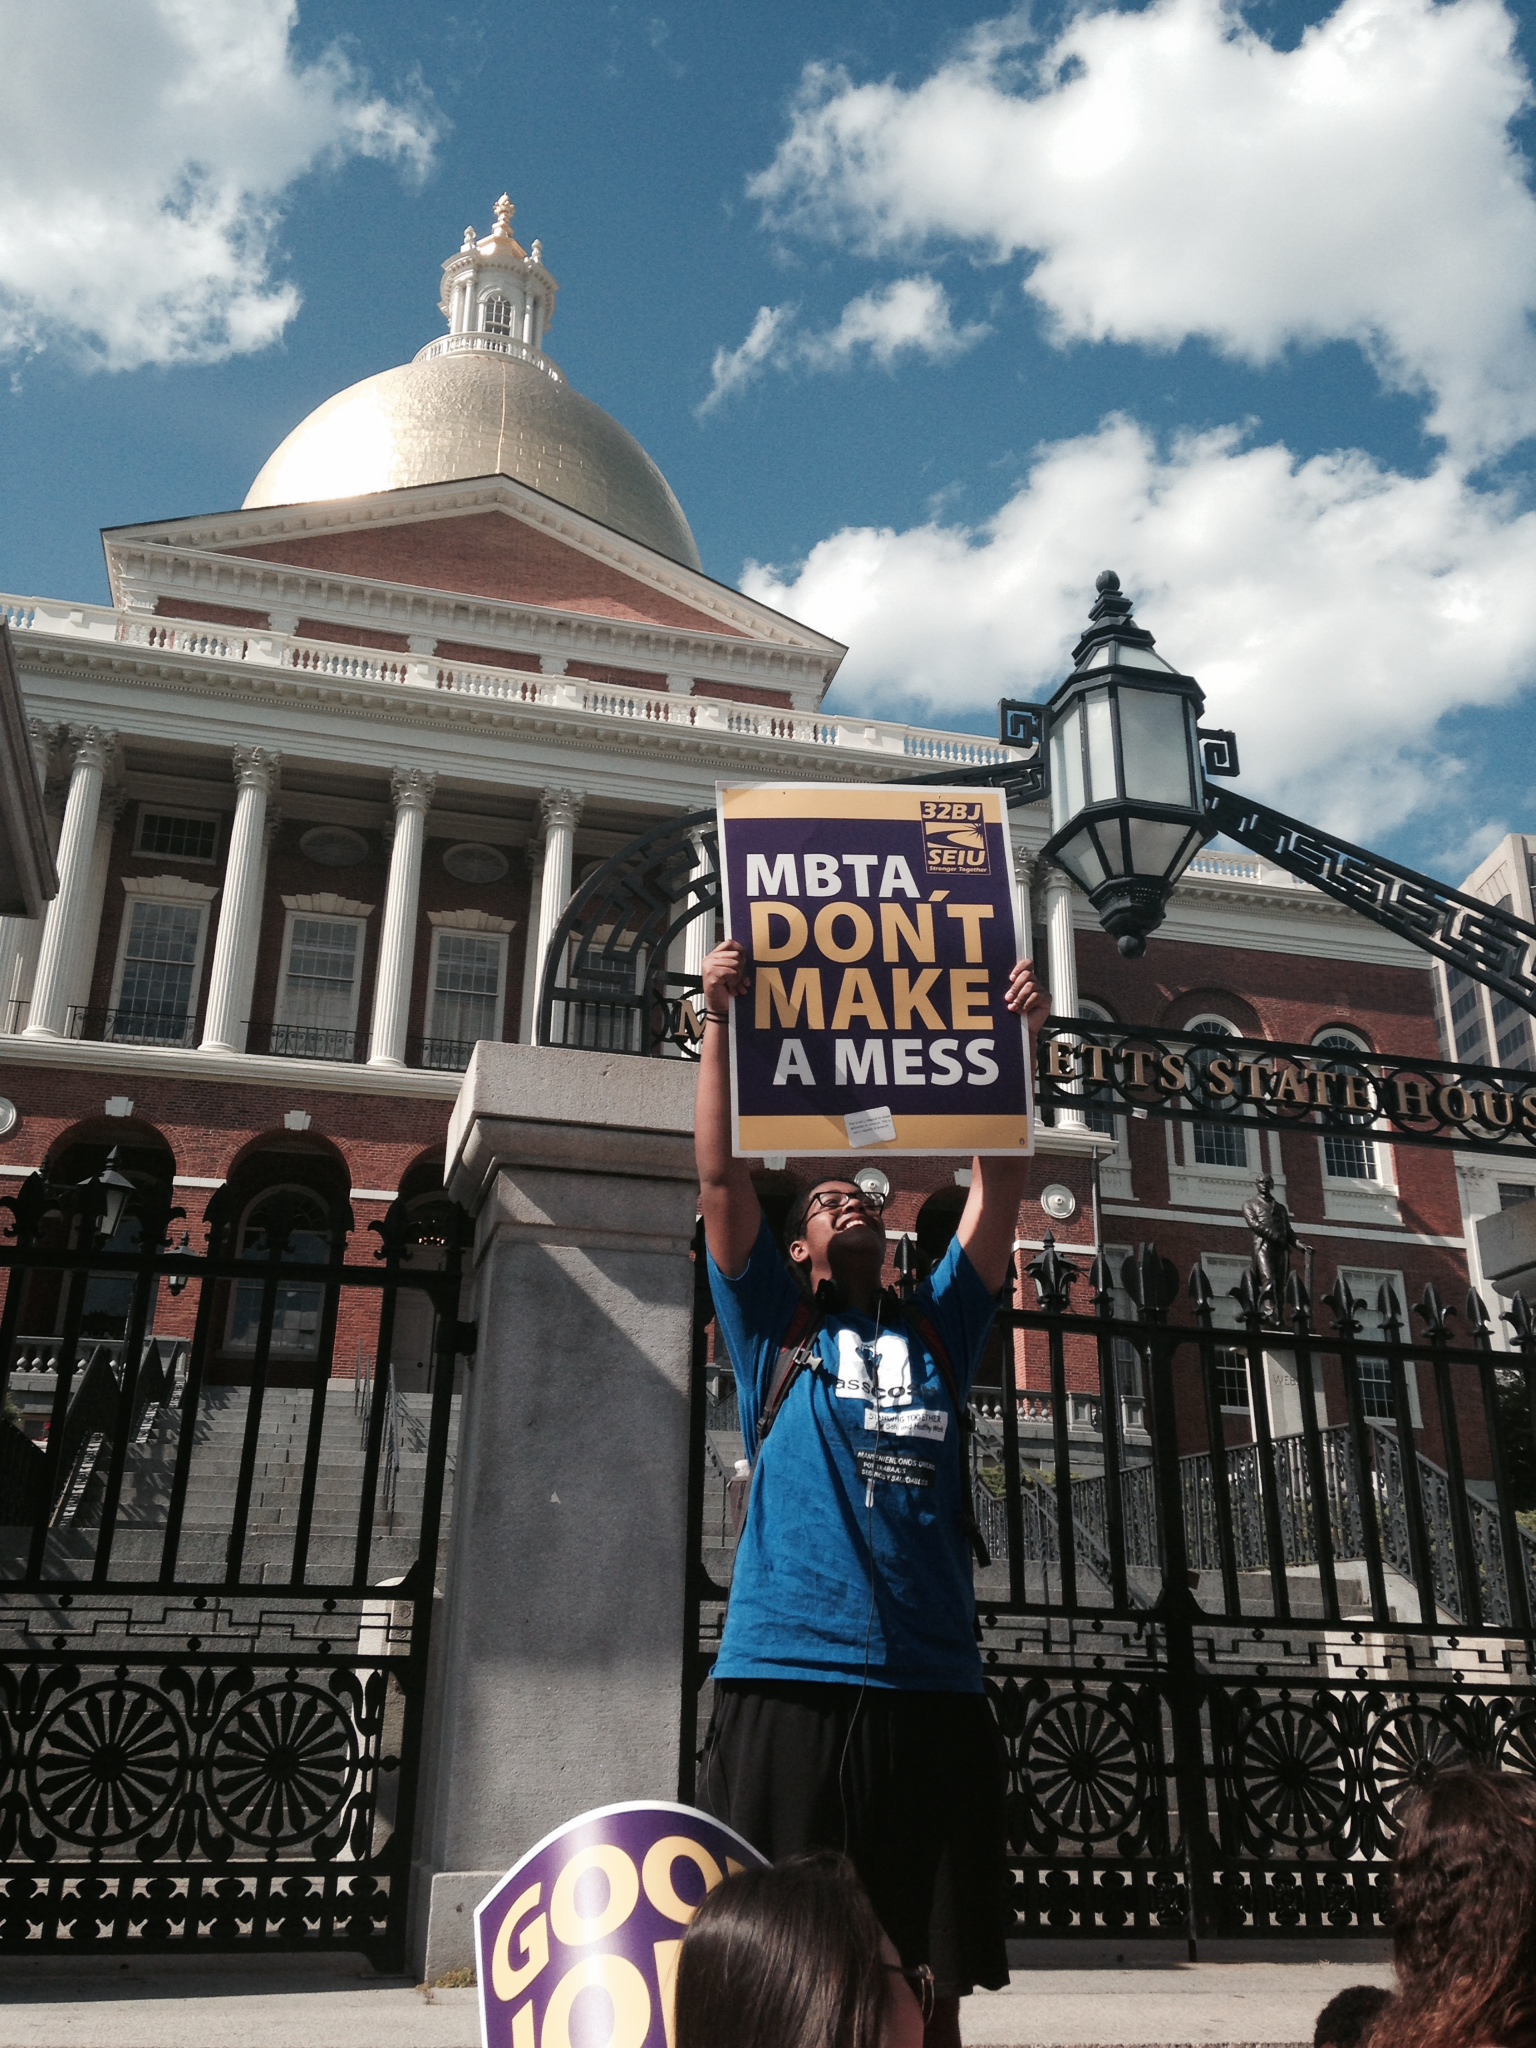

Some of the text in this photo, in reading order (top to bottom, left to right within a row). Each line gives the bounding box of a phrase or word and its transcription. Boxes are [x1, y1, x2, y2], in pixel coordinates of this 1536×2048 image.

[923, 803, 981, 820] 32BJ
[746, 854, 921, 897] MBTA
[928, 849, 986, 866] SEIU
[754, 967, 994, 1030] MAKE
[772, 1038, 1000, 1086] A MESS
[1209, 1059, 1375, 1111] STATE
[907, 1413, 941, 1423] TOGETHER
[861, 1469, 885, 1480] SEGROS
[492, 1836, 746, 2001] GOO
